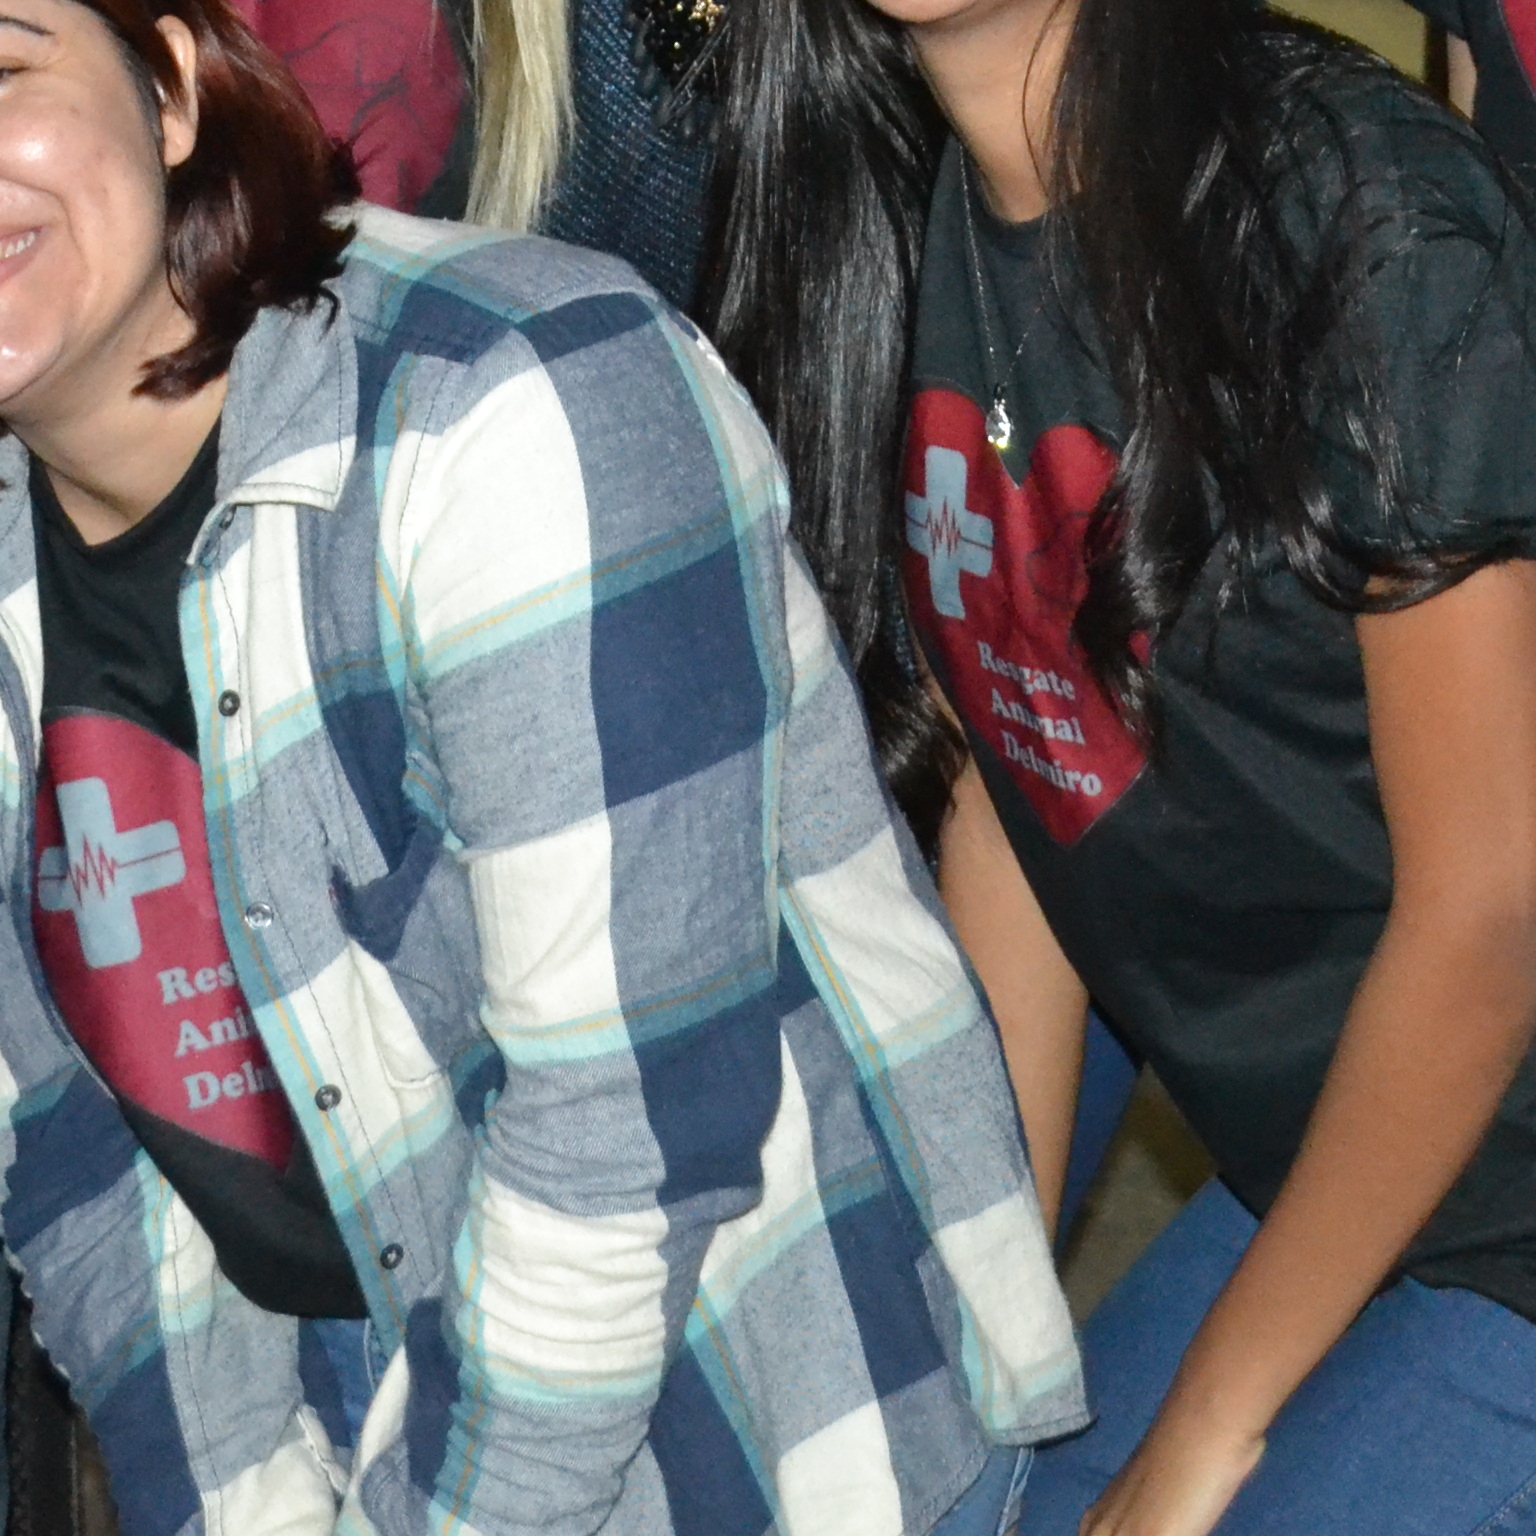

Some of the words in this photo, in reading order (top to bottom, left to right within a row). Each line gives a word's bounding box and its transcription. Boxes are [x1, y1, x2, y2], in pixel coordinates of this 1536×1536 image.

[977, 640, 1076, 701] Resgate
[1000, 729, 1103, 797] Delmiro
[174, 1006, 259, 1058] Ani
